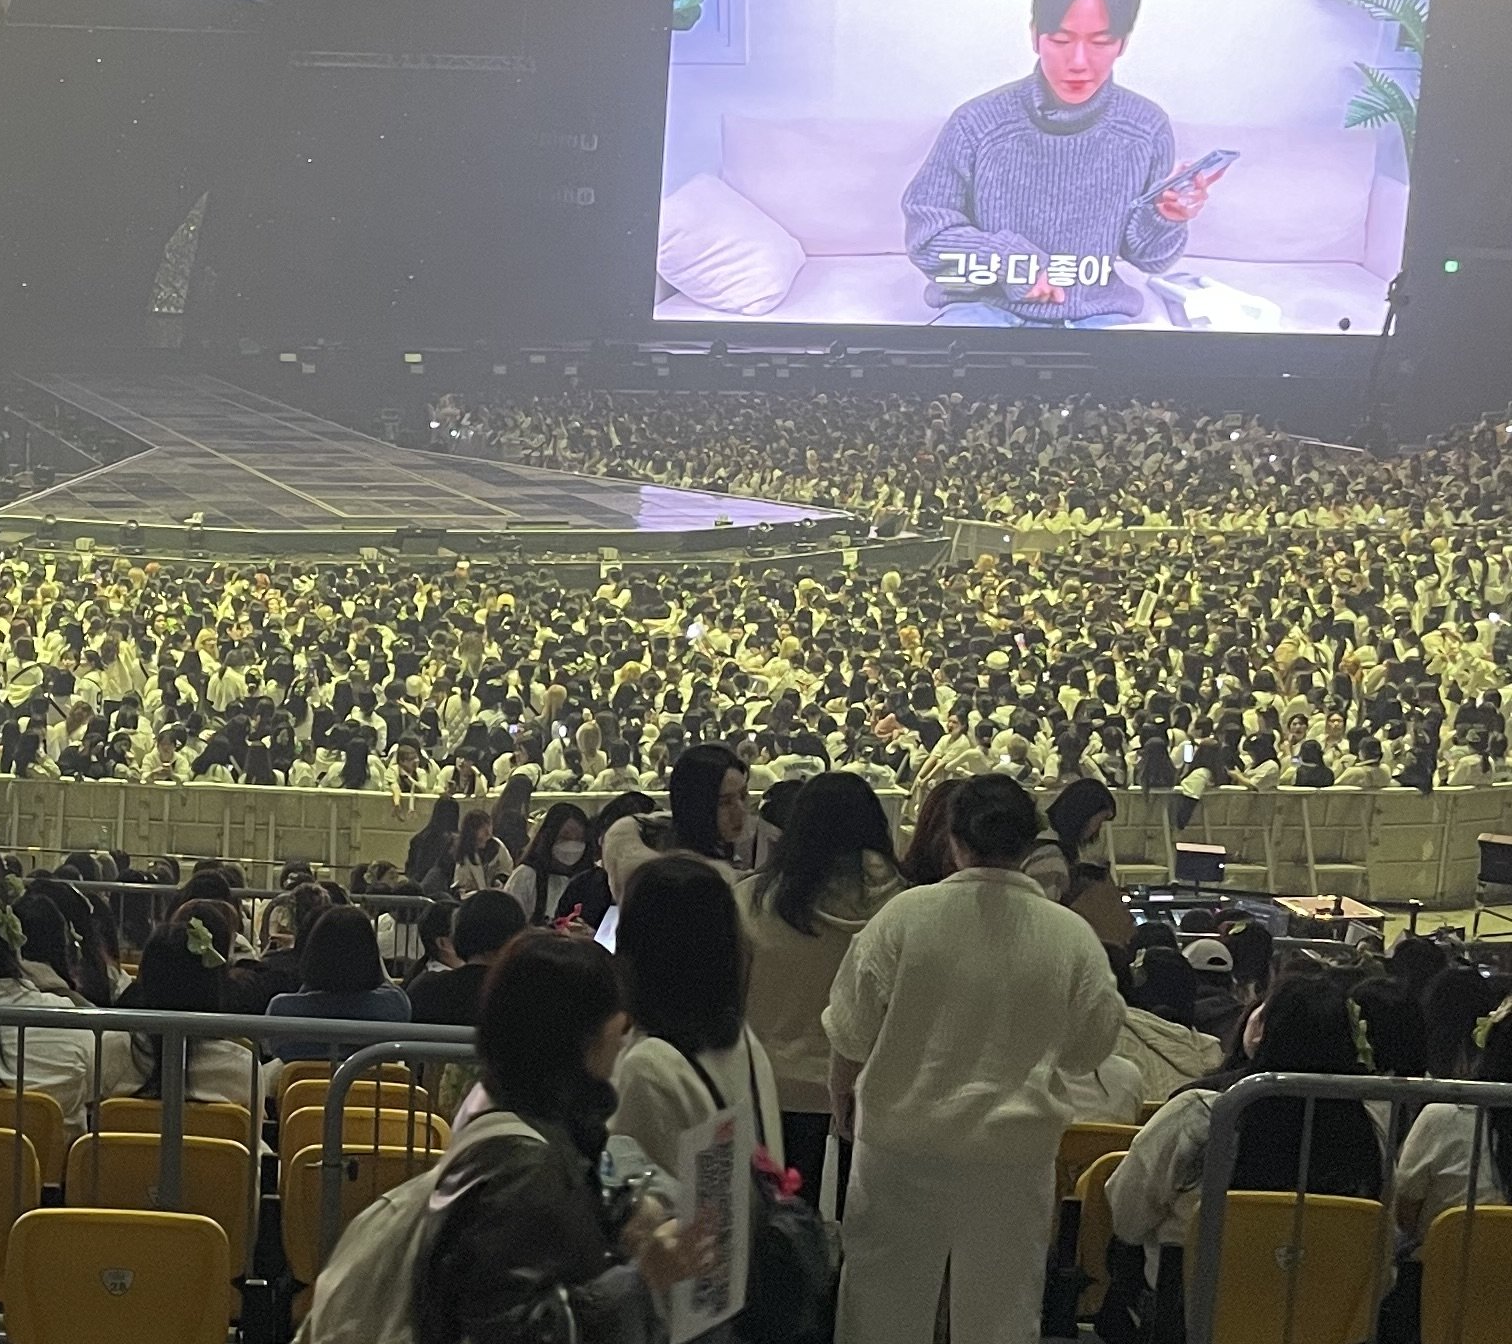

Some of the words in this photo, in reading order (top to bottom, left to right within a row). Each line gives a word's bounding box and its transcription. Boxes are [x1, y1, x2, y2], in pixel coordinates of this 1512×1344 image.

[935, 253, 1001, 285] 그냥
[1006, 254, 1039, 285] 다
[1047, 255, 1112, 286] 좋아
